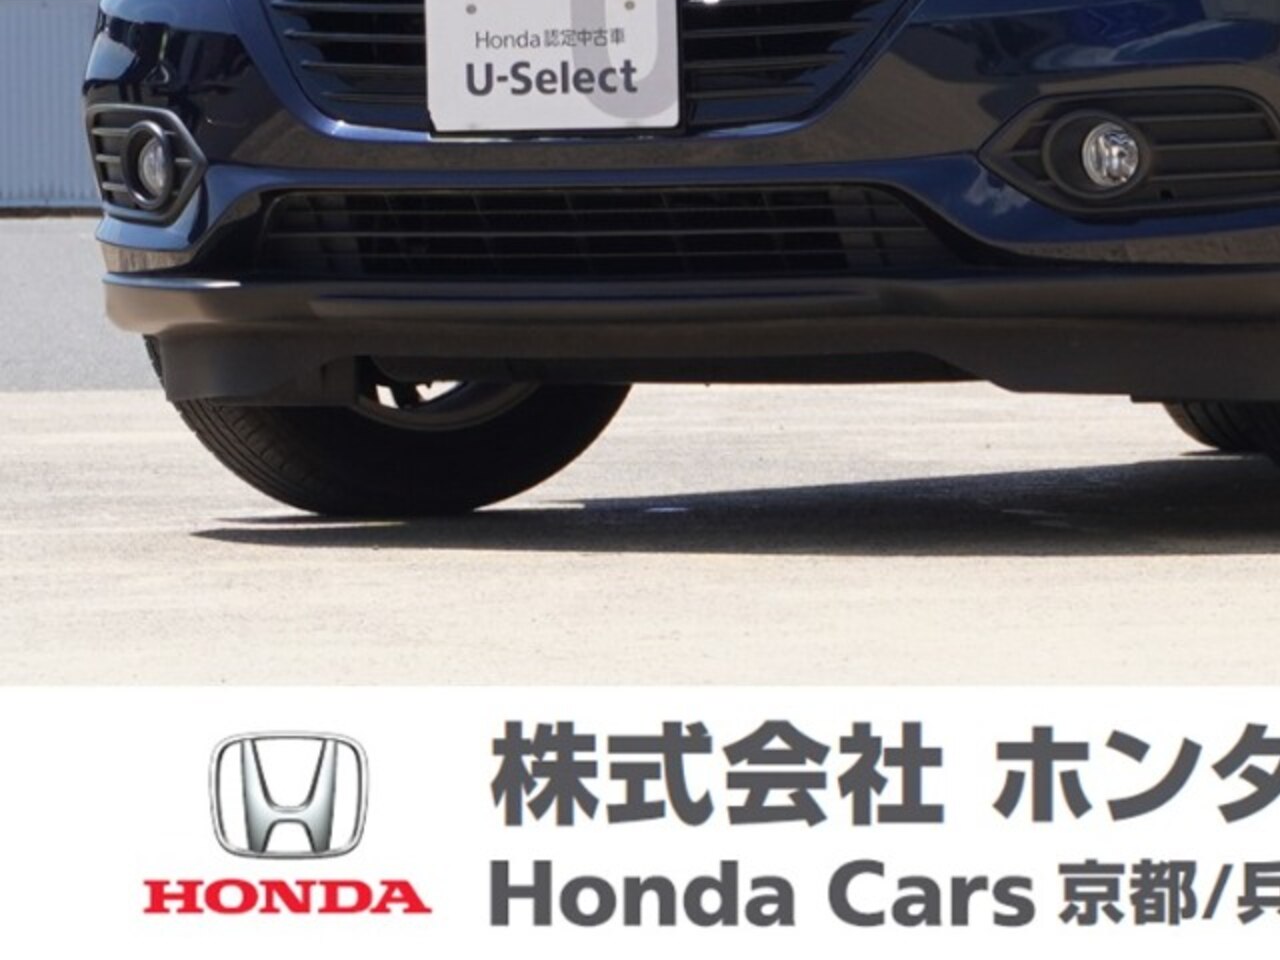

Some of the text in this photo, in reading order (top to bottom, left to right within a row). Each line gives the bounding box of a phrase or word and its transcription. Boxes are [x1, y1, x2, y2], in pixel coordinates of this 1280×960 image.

[475, 28, 626, 49] Honda 認定中古車
[465, 59, 638, 96] U-Select
